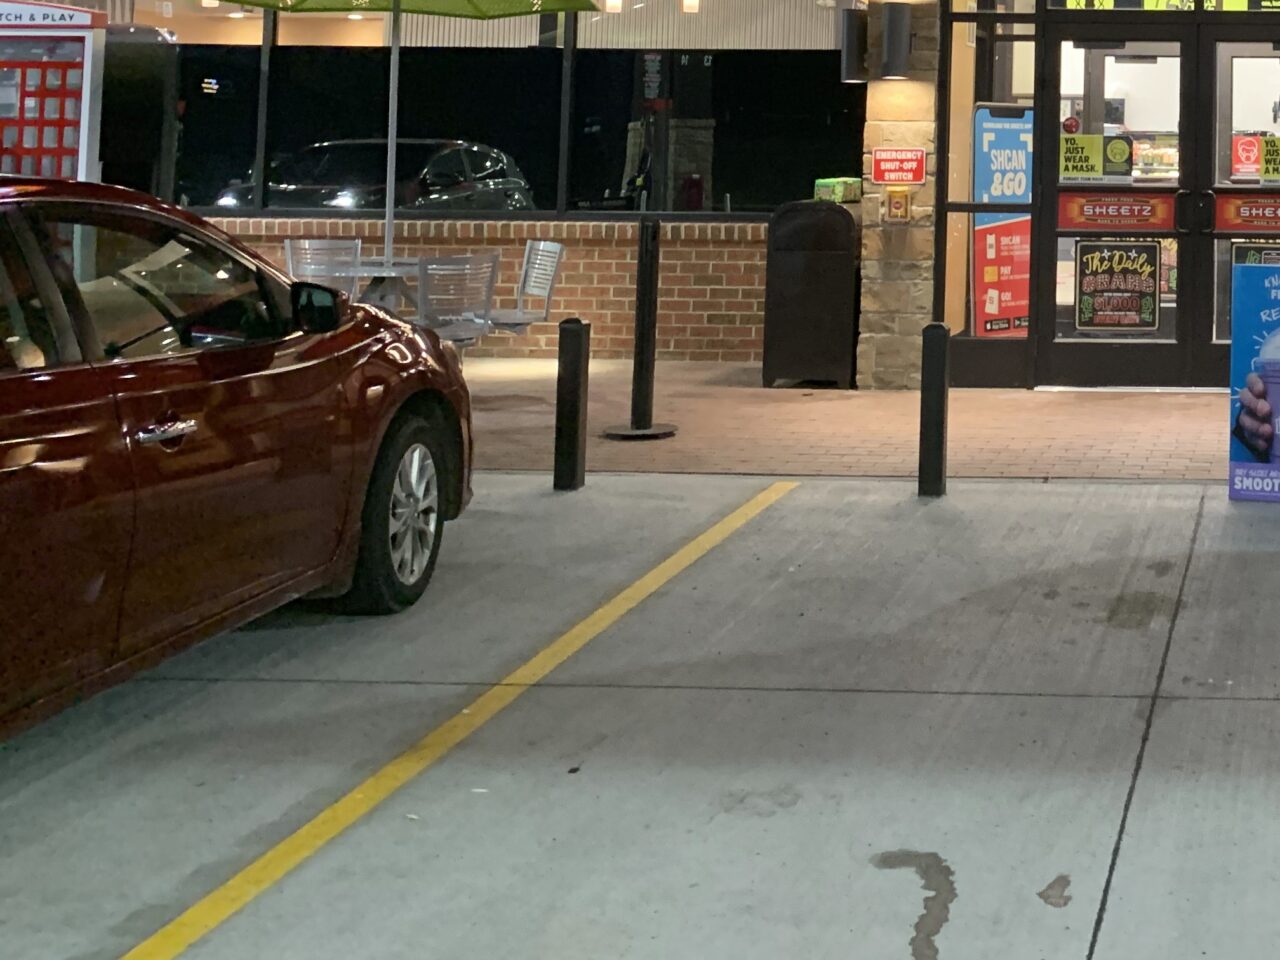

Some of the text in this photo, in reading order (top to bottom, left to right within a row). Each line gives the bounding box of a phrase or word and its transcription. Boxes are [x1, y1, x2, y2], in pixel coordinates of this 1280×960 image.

[29, 13, 36, 21] &
[42, 13, 75, 22] PLAY
[1064, 138, 1078, 146] YO.
[1264, 140, 1278, 148] YO.
[876, 151, 922, 159] EMERGENCY
[990, 149, 1026, 171] SHCAN
[880, 161, 917, 170] SHUT-OFF
[1264, 167, 1271, 175] A
[884, 172, 913, 180] SWITCH
[1083, 205, 1152, 215] SHEETZ
[1083, 251, 1111, 274] The
[1112, 250, 1154, 279] Daily
